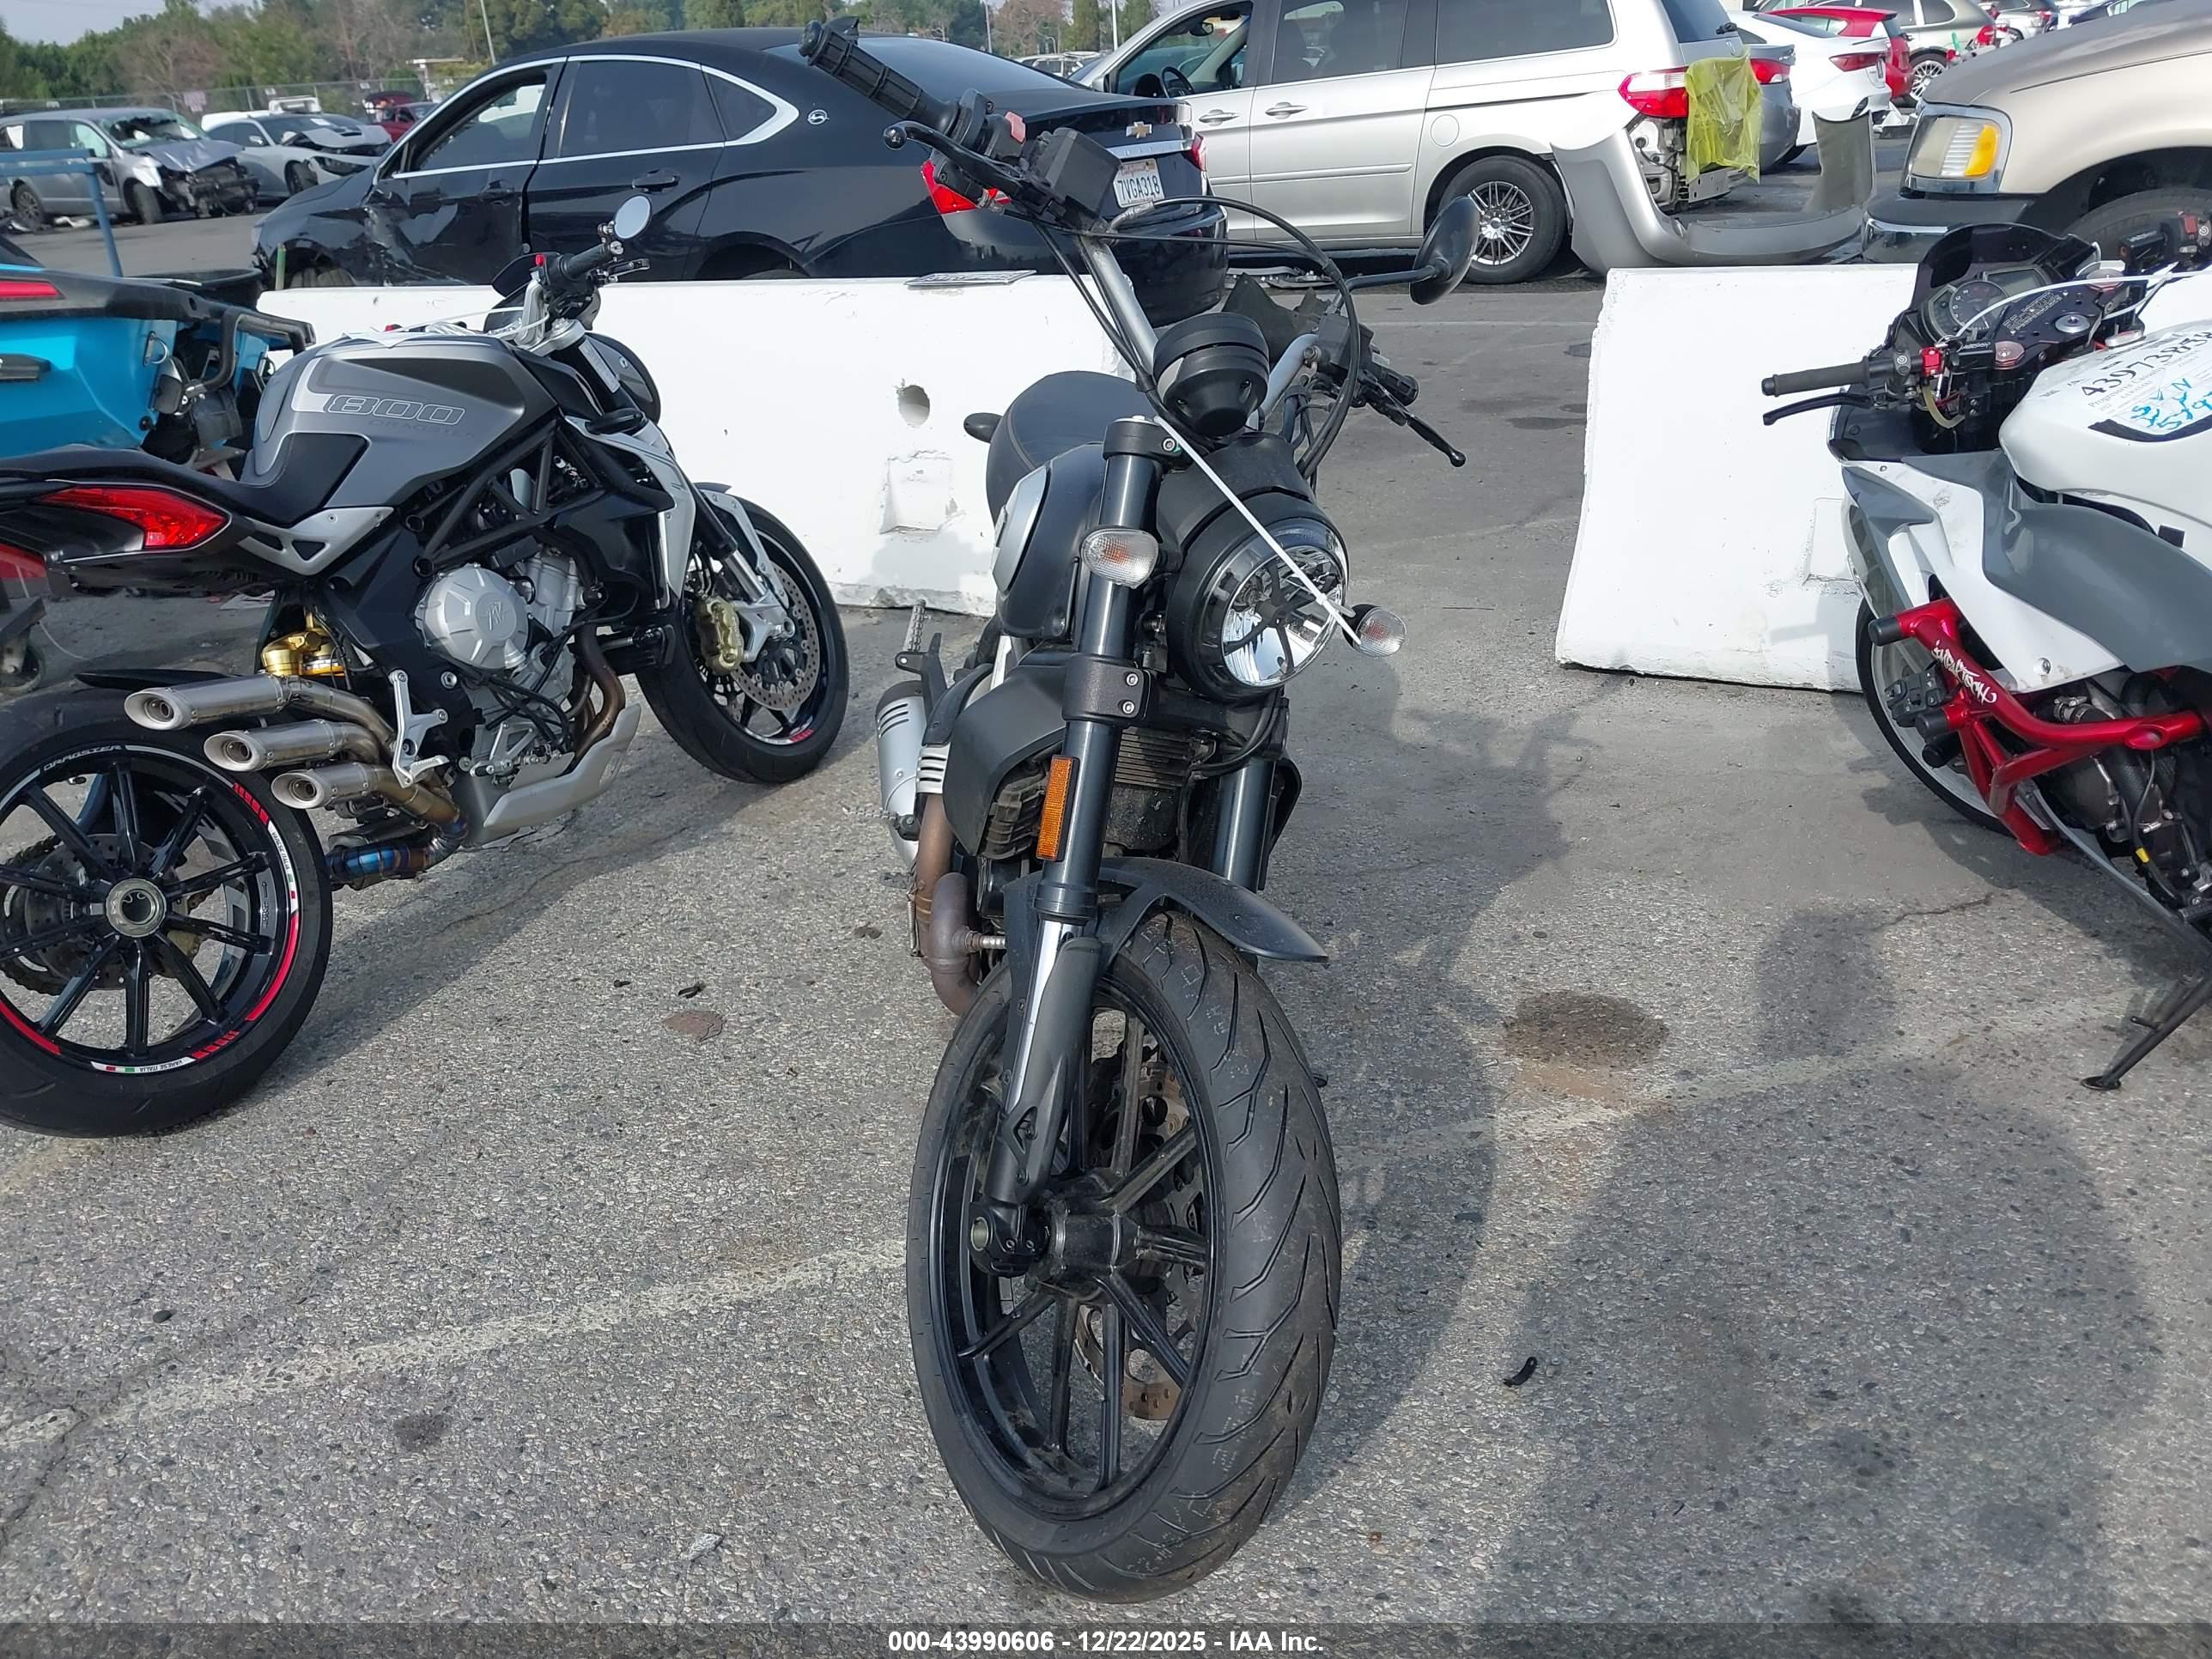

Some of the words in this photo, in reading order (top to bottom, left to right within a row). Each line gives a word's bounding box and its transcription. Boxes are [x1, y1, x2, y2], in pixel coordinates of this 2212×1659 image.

[1116, 174, 1160, 201] 7VGA318
[327, 394, 465, 425] 800
[43, 744, 123, 772] DRAGSTER
[271, 830, 286, 854] VARESE
[281, 853, 291, 871] ITALIA
[160, 1060, 183, 1071] VARESE
